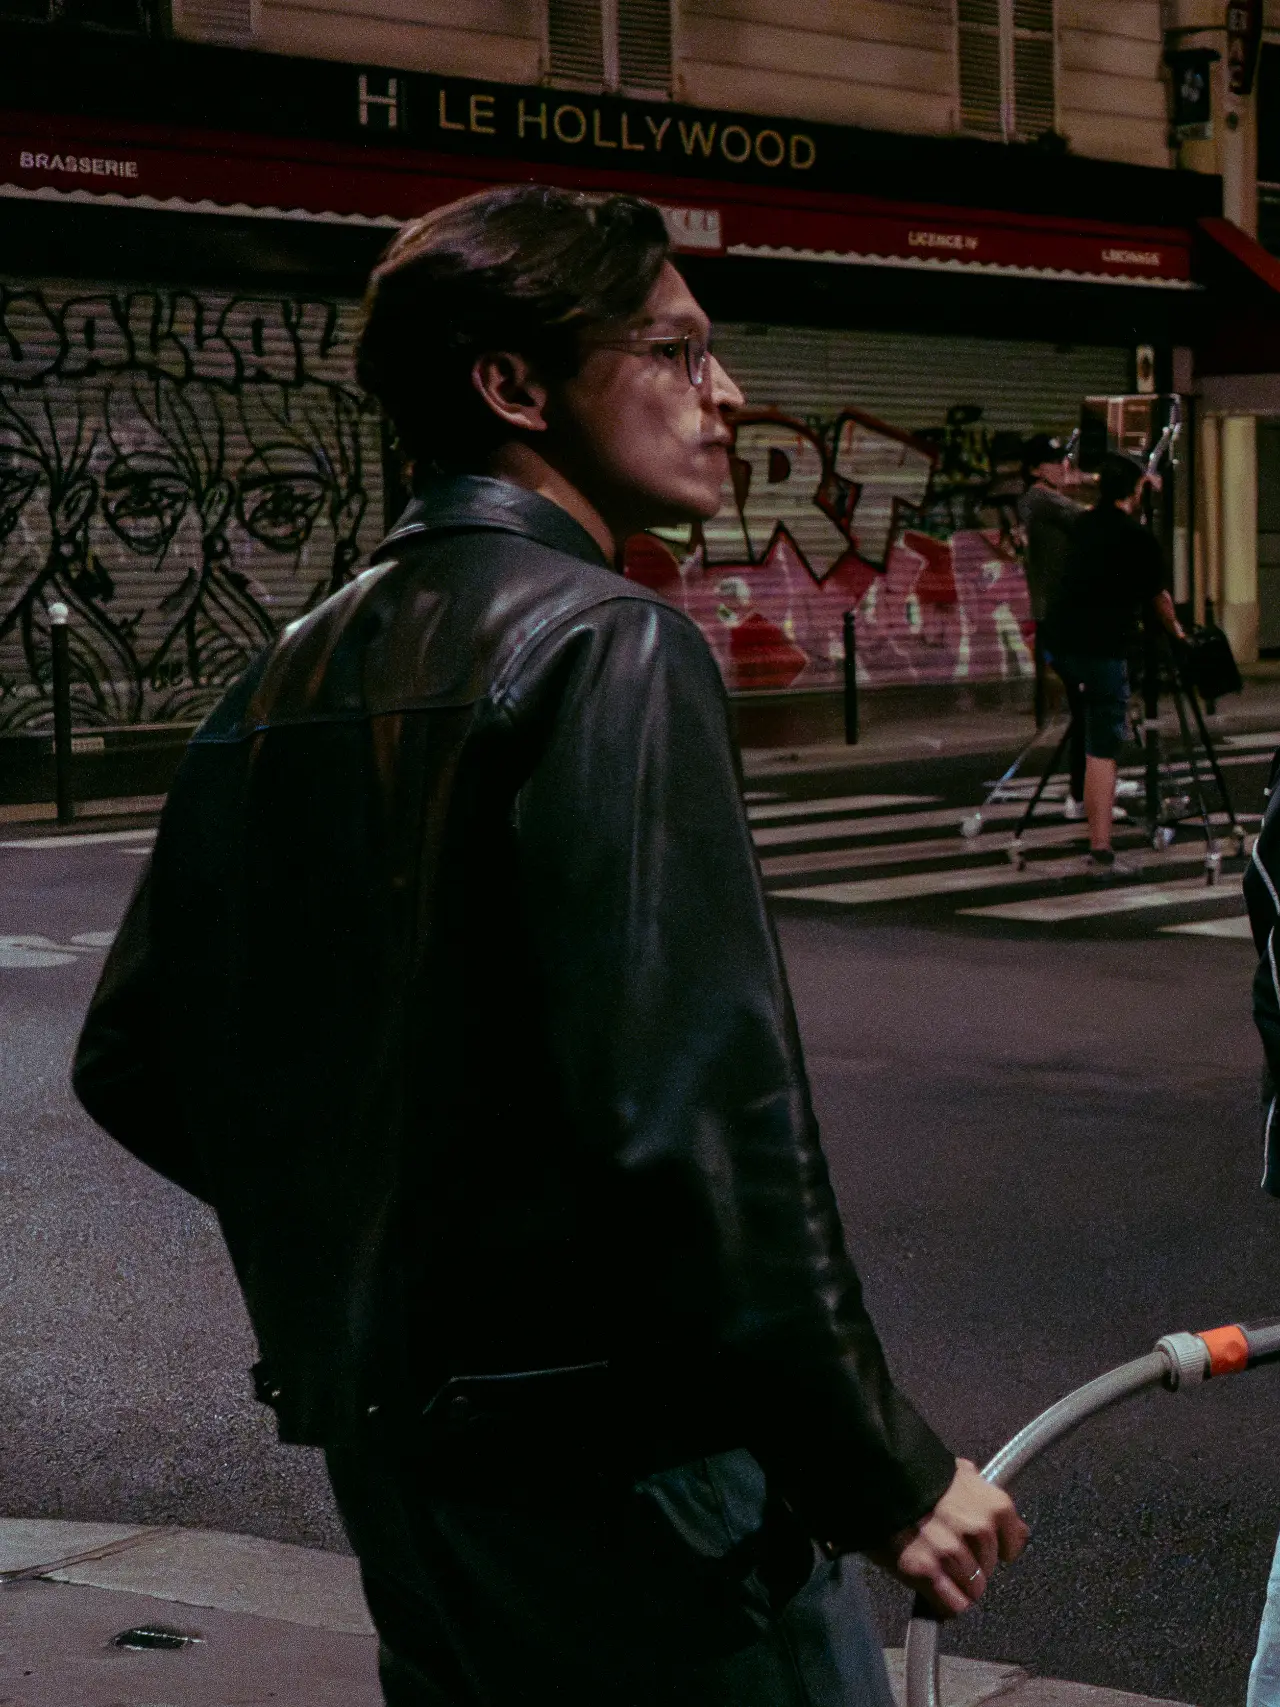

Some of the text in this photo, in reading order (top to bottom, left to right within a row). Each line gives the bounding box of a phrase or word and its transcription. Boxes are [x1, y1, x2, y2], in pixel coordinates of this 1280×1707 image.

[358, 73, 818, 171] H LE HOLLYWOOD
[19, 151, 139, 178] BRASSERIE
